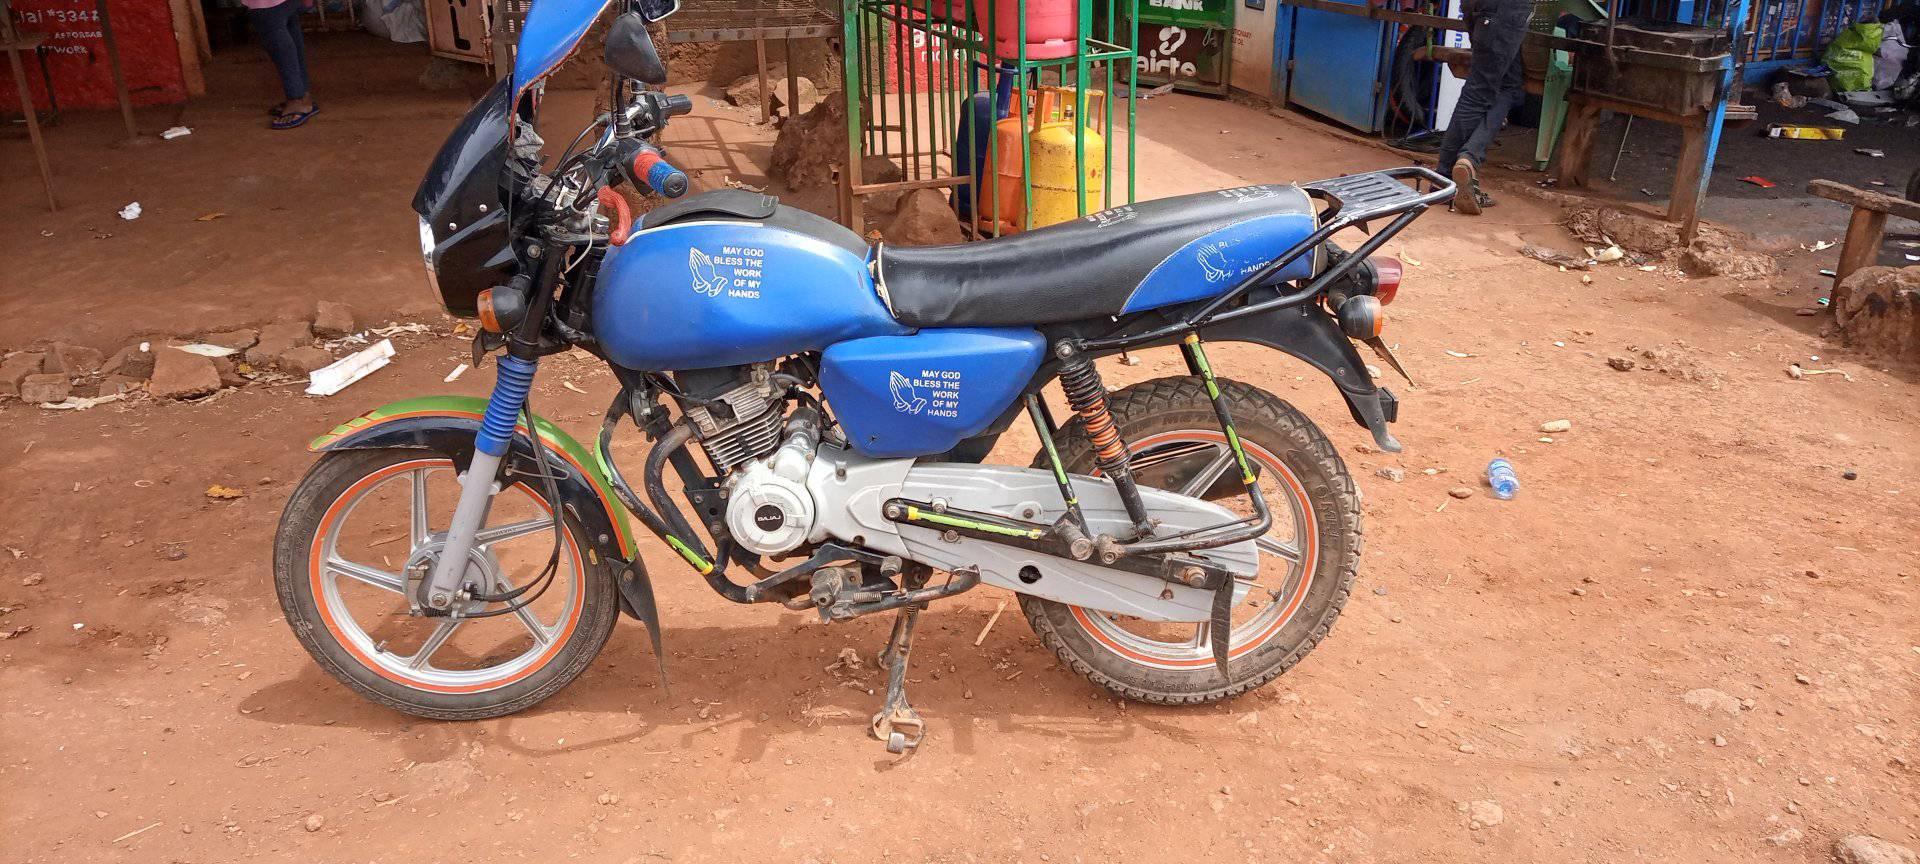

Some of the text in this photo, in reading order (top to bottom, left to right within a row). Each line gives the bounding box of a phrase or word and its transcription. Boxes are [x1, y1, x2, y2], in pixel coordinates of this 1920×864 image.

[723, 246, 764, 256] MAY GOD
[714, 256, 763, 267] BLESS THE
[734, 268, 761, 277] WORK
[734, 279, 761, 288] OF MY
[728, 289, 760, 298] HANDS
[922, 370, 960, 379] MAY GOD
[913, 379, 960, 389] BLESS THE
[933, 391, 958, 399] WORK
[928, 409, 957, 417] HANDS
